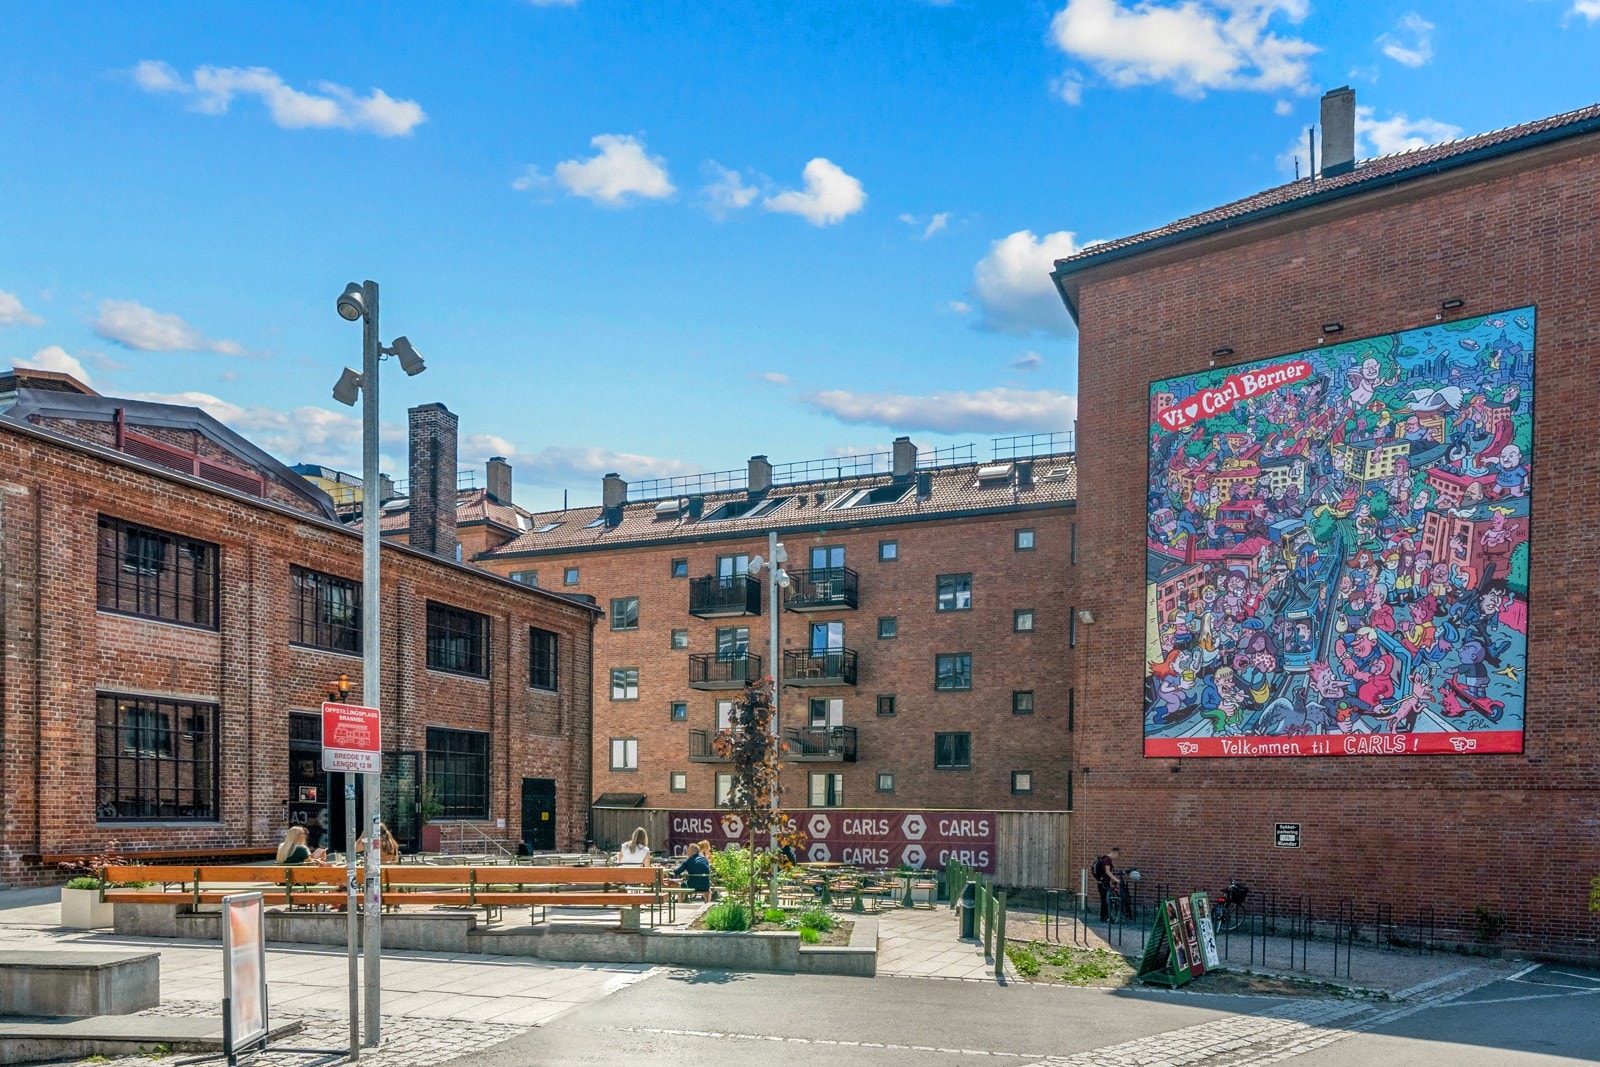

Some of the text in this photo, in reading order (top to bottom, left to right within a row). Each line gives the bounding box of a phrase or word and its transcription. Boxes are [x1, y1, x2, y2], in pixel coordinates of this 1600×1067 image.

[1162, 365, 1305, 426] Vi Carl Berner
[325, 707, 378, 719] OPPSTILLINGSPLASS
[1221, 739, 1301, 755] Velkommen
[1312, 740, 1330, 754] til
[1343, 734, 1406, 754] CARLS
[333, 761, 358, 769] LENGDE
[334, 752, 359, 761] BREDDE
[673, 818, 713, 834] CARLS
[842, 818, 890, 835] CARLS
[938, 819, 990, 837] CARLS
[842, 848, 889, 865] CARLS
